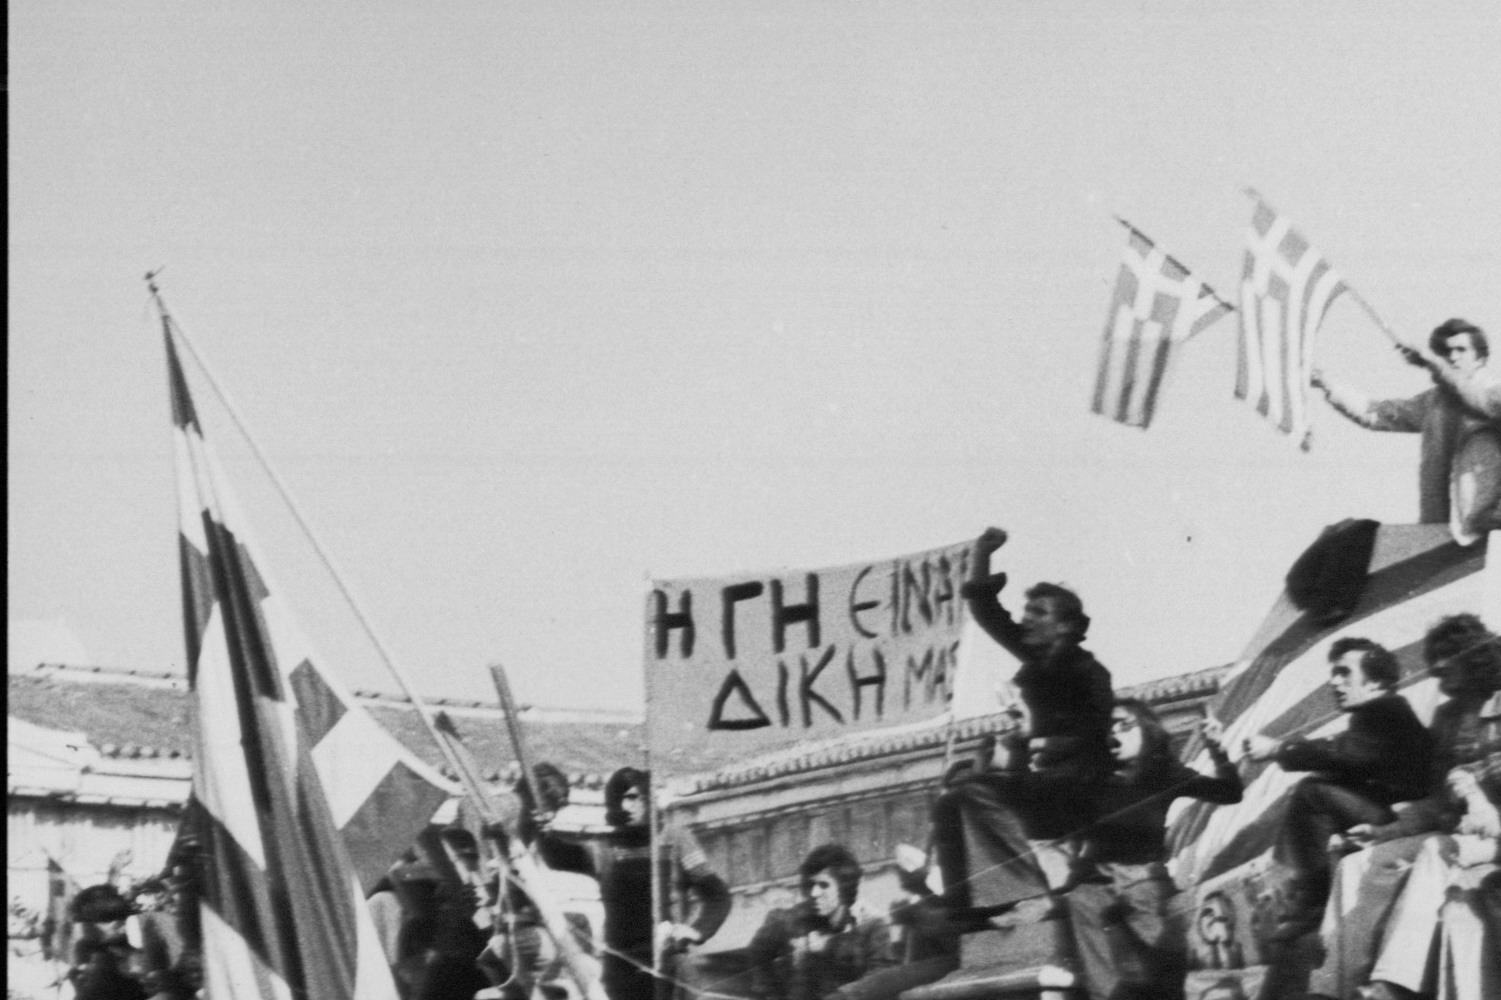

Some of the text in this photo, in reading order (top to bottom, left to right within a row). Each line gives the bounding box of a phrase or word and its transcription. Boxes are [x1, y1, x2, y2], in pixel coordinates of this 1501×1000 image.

[653, 588, 695, 659] Η
[722, 572, 820, 660] ΓΗ
[706, 642, 887, 731] ΔΙΚΗ
